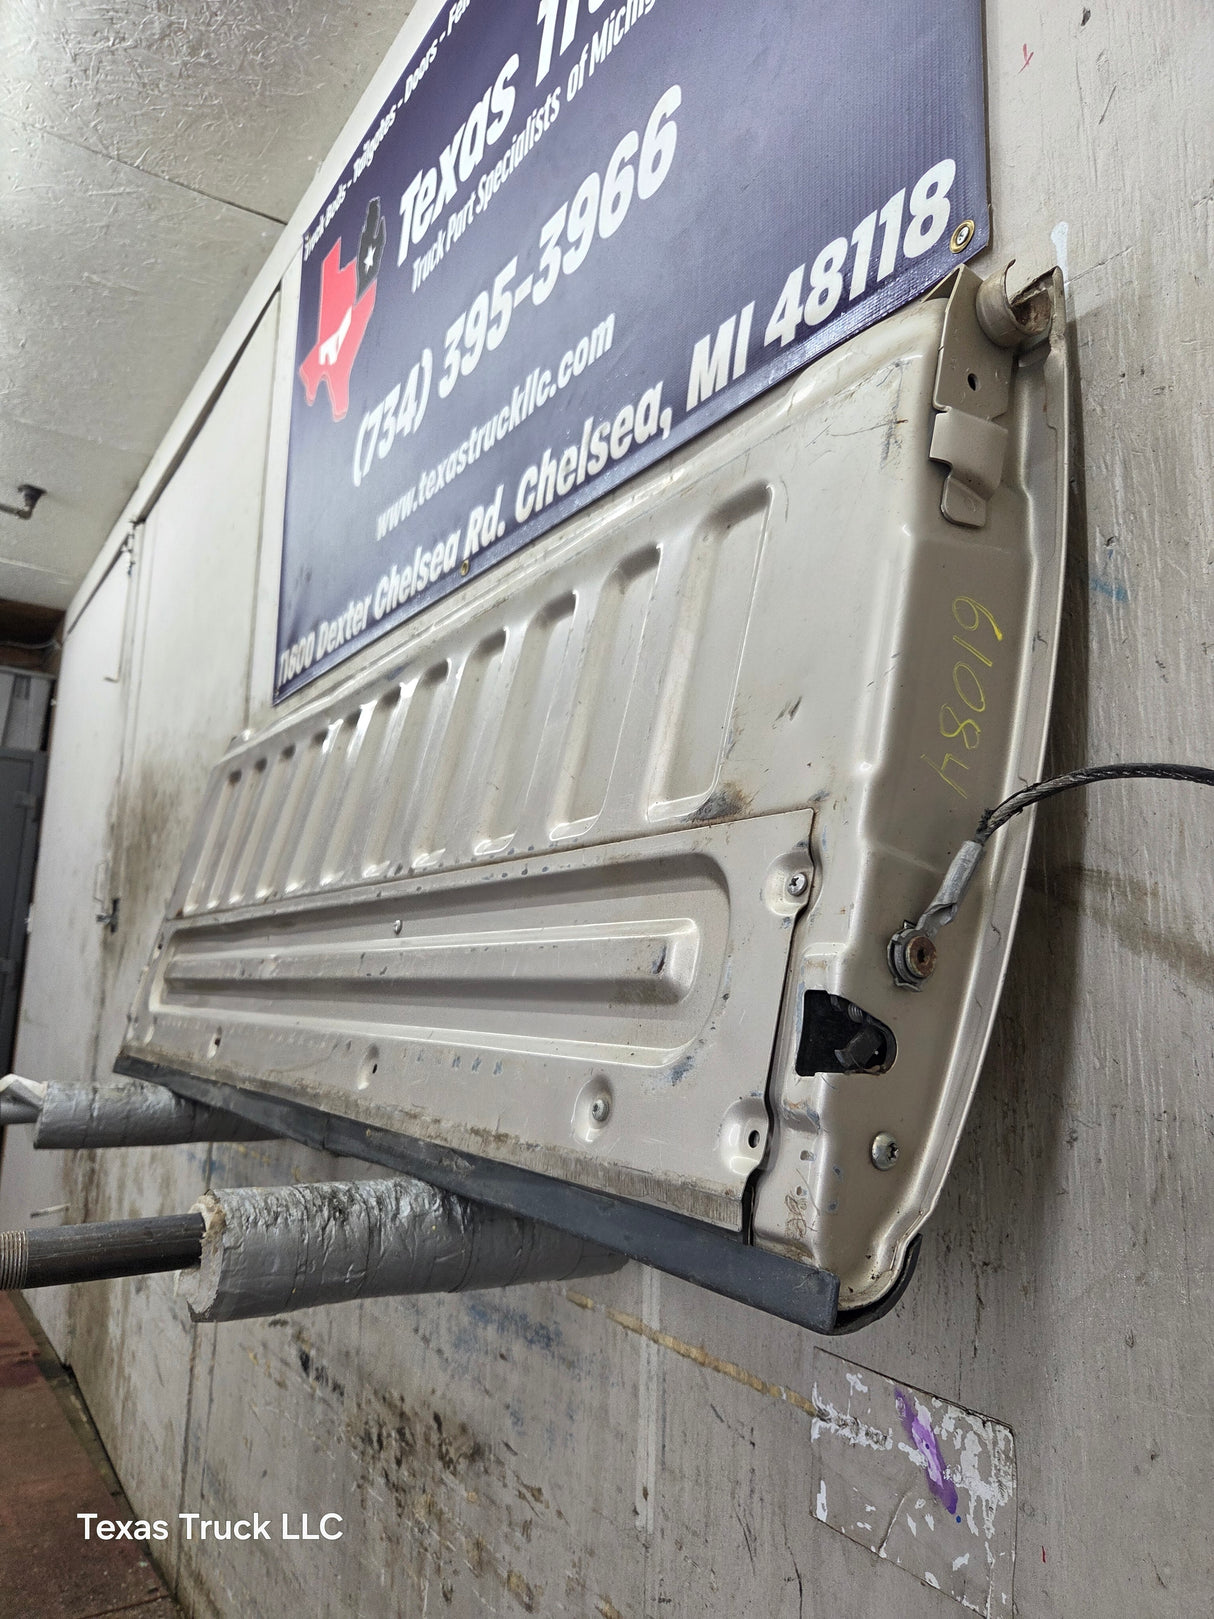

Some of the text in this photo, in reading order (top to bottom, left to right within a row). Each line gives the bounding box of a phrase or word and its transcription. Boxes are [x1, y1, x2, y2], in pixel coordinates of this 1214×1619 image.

[397, 0, 603, 267] Texas Tr
[404, 38, 437, 103] Doors
[411, 230, 447, 293] Truck
[448, 190, 476, 252] Part
[476, 86, 561, 214] Specialists
[566, 43, 589, 102] of
[316, 594, 372, 663] Dexter
[373, 528, 461, 622] Chelsea
[463, 484, 506, 560] Rd.
[514, 380, 673, 523] Chelsea,
[685, 300, 756, 412] MI
[763, 157, 957, 349] 48118
[352, 84, 682, 487] (734) 395-3966
[376, 312, 616, 541] www.texastruckllc.com
